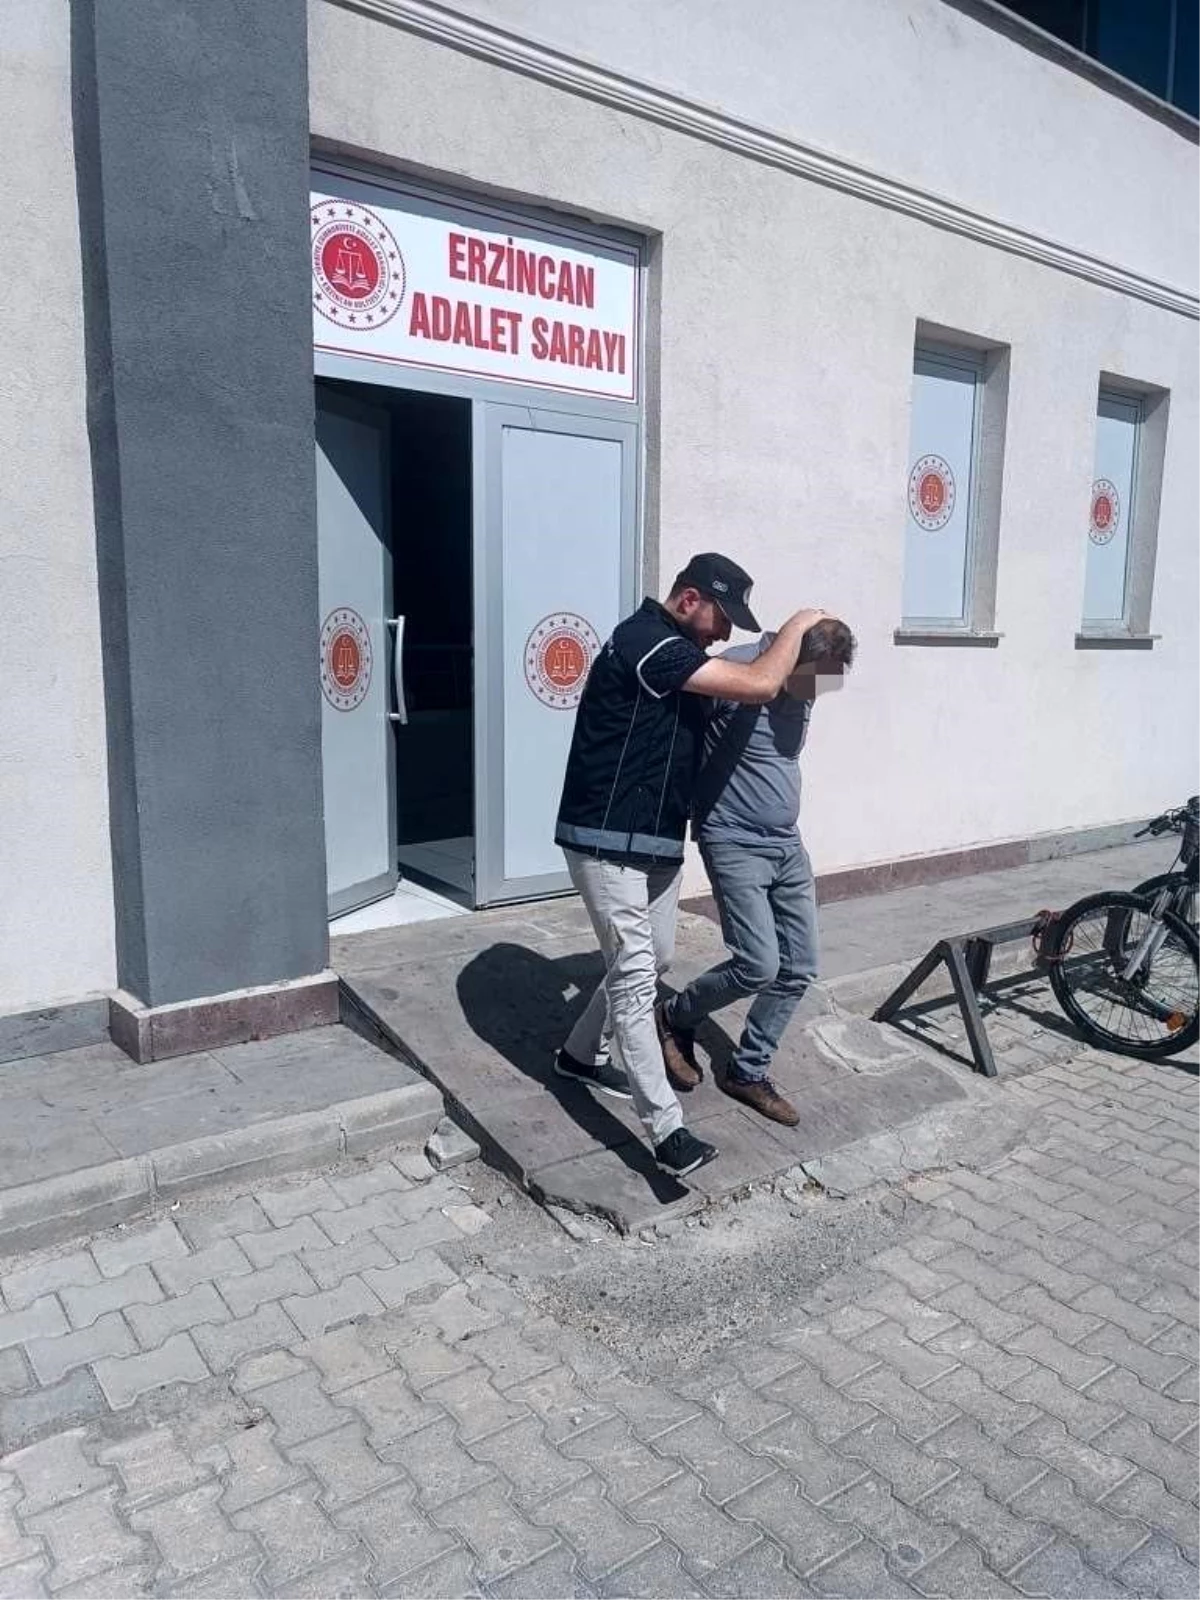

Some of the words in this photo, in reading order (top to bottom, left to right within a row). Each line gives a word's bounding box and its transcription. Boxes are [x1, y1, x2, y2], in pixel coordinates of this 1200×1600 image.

[449, 232, 594, 309] ERZİNCAN
[409, 291, 522, 355] ADALET
[531, 316, 626, 375] SARAYI
